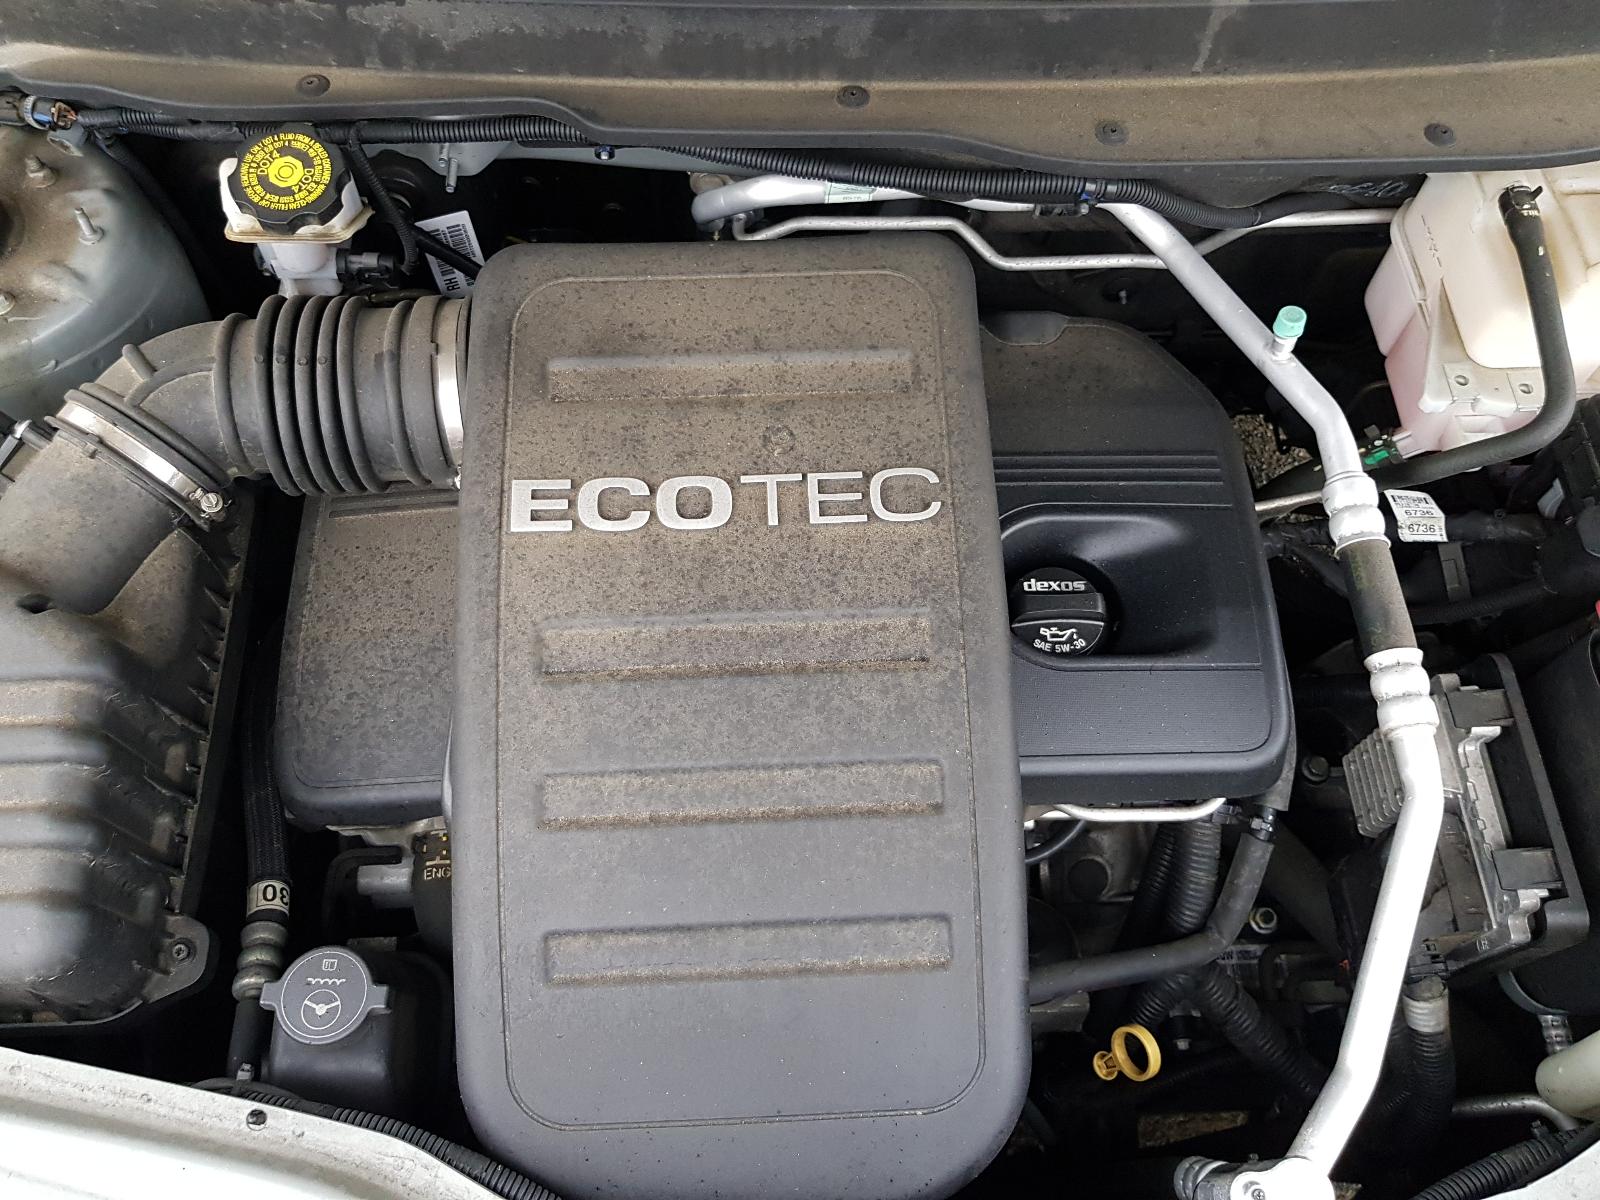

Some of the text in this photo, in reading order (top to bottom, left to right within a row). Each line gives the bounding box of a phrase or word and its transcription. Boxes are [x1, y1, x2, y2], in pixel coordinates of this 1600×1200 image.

[261, 135, 273, 145] DOT
[295, 133, 311, 143] FROM
[249, 141, 264, 153] ONLY
[312, 142, 328, 158] SEALED
[242, 152, 253, 162] USE
[321, 157, 331, 184] CONTAINER
[243, 186, 261, 203] BEFORE
[258, 199, 270, 208] CAP
[444, 277, 460, 291] RH
[510, 467, 942, 532] ECOTEC
[1407, 523, 1436, 533] 6736
[1023, 578, 1087, 592] dexos
[1033, 638, 1087, 653] SAE 5W-30
